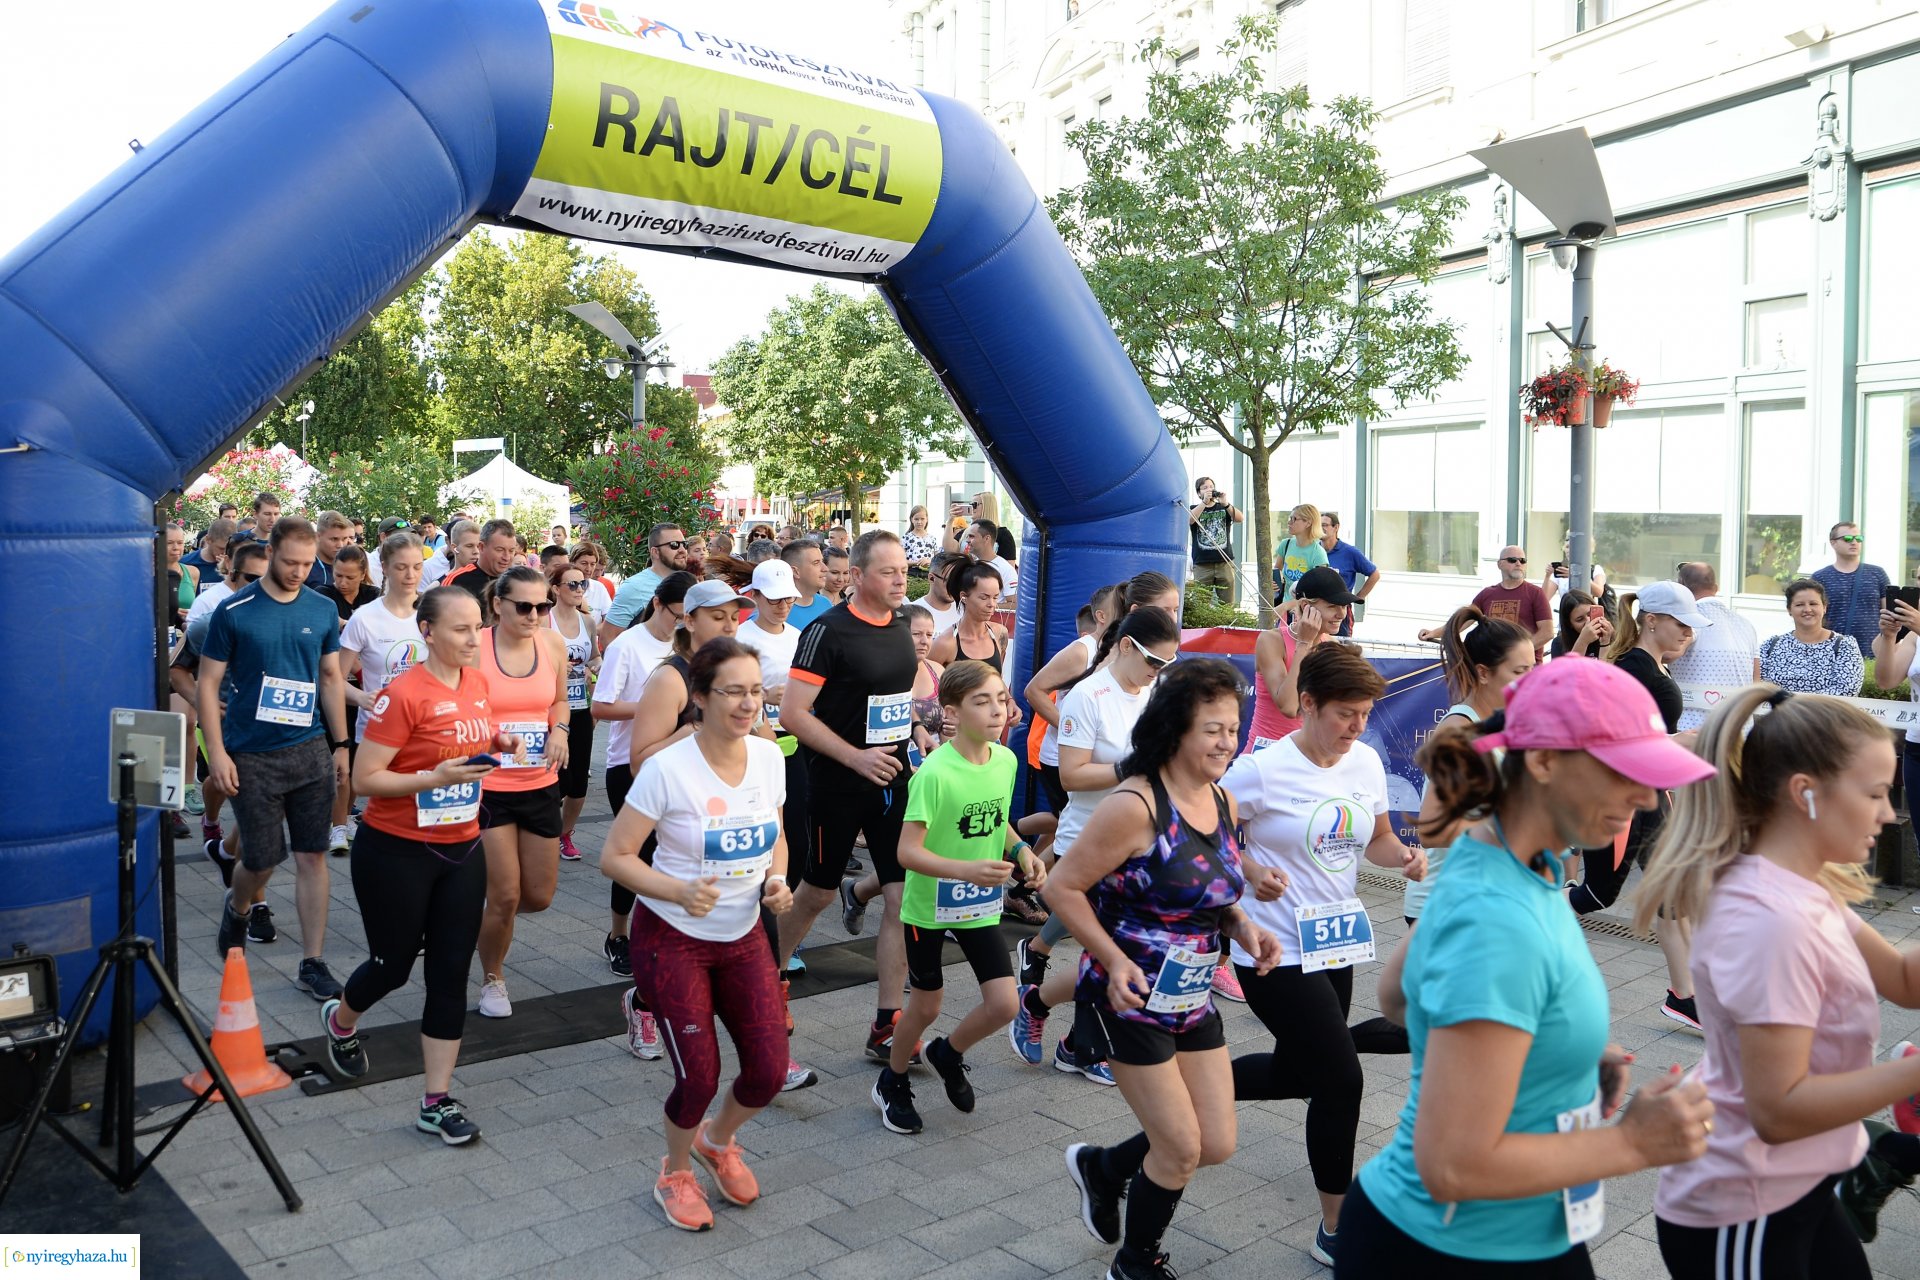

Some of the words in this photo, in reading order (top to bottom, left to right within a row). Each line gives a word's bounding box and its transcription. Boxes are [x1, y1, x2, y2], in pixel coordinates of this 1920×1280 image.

[706, 48, 723, 58] az
[592, 82, 904, 205] RAJT/CÉL
[538, 196, 891, 265] www.nyiregyhazifutofesztival.hu
[272, 689, 308, 707] 513
[567, 686, 582, 697] 40
[880, 703, 911, 723] 632
[454, 717, 490, 744] RUN
[523, 732, 545, 748] 93
[439, 746, 461, 760] FOR
[166, 786, 176, 802] 7
[432, 782, 474, 802] 546
[963, 797, 1004, 816] CRAZY
[968, 812, 998, 835] 5K
[720, 826, 766, 853] 631
[951, 883, 994, 901] 633
[1314, 914, 1357, 942] 517
[1177, 965, 1215, 988] 543
